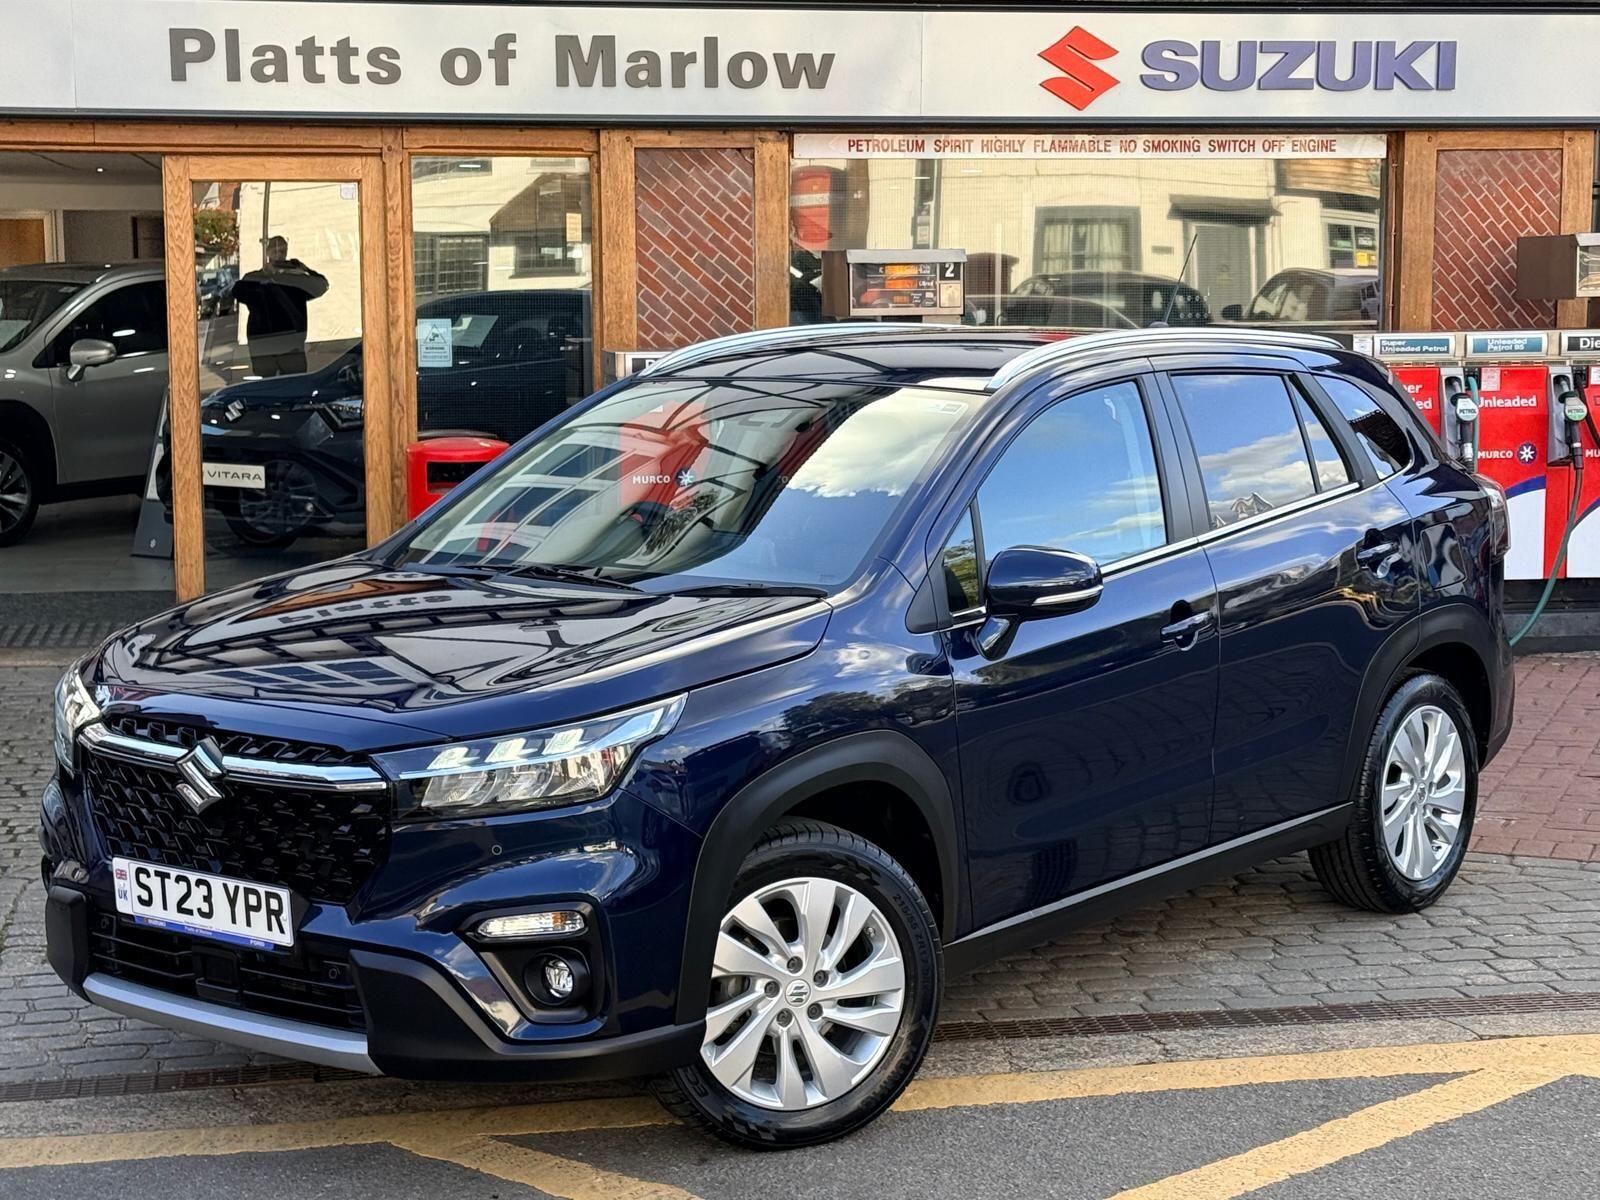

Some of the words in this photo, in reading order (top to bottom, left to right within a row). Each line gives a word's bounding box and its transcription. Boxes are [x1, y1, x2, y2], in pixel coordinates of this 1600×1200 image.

[169, 28, 402, 85] Platts
[441, 34, 516, 86] of
[556, 35, 835, 90] Marlow
[1140, 40, 1457, 92] SUZUKI
[848, 139, 925, 153] PETROLEUM
[934, 139, 974, 153] SPIRIT
[981, 139, 1025, 153] HIGHLY
[1034, 139, 1111, 153] FLAMMABLE
[1120, 139, 1137, 153] NO
[1143, 139, 1201, 153] SMOKING
[1208, 139, 1255, 153] SWITCH
[1262, 139, 1285, 153] OFF
[1291, 139, 1337, 153] ENGINE
[945, 262, 955, 278] 2
[1580, 337, 1600, 349] Die
[1478, 396, 1537, 408] Unleaded
[1478, 450, 1513, 459] MURCO
[207, 470, 262, 481] VITARA
[633, 475, 671, 484] MURCO
[118, 888, 128, 901] UK
[135, 866, 214, 920] ST23
[222, 883, 286, 935] YPR
